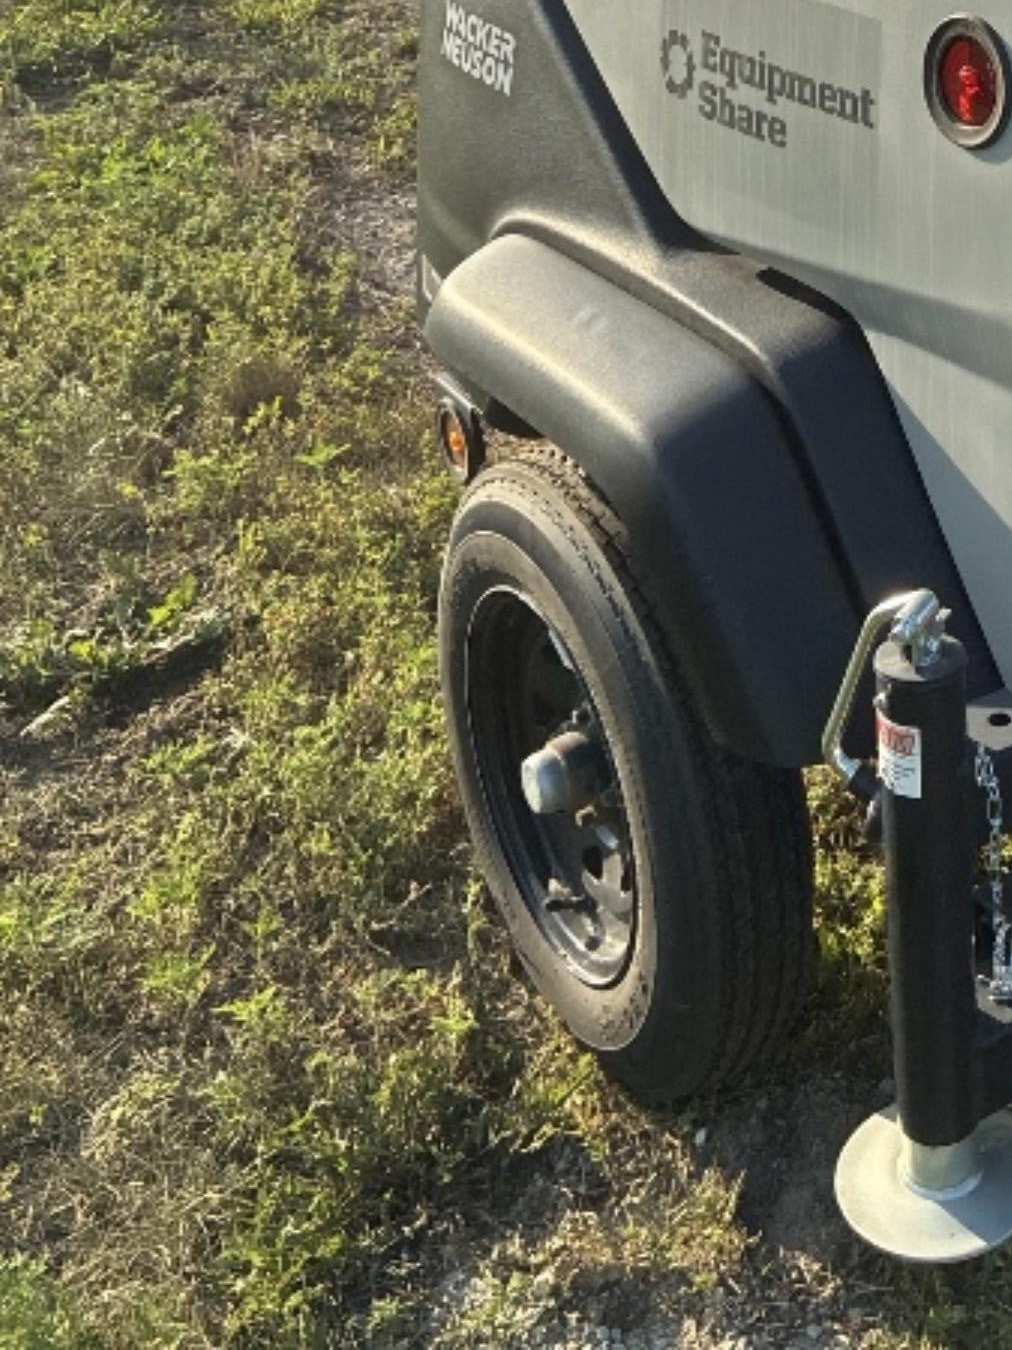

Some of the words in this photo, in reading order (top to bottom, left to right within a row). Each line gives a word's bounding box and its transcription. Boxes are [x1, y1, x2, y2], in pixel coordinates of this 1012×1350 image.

[441, 28, 514, 97] NEUSON
[445, 0, 517, 65] WACKER
[701, 29, 876, 130] Equipment
[698, 80, 787, 148] Share
